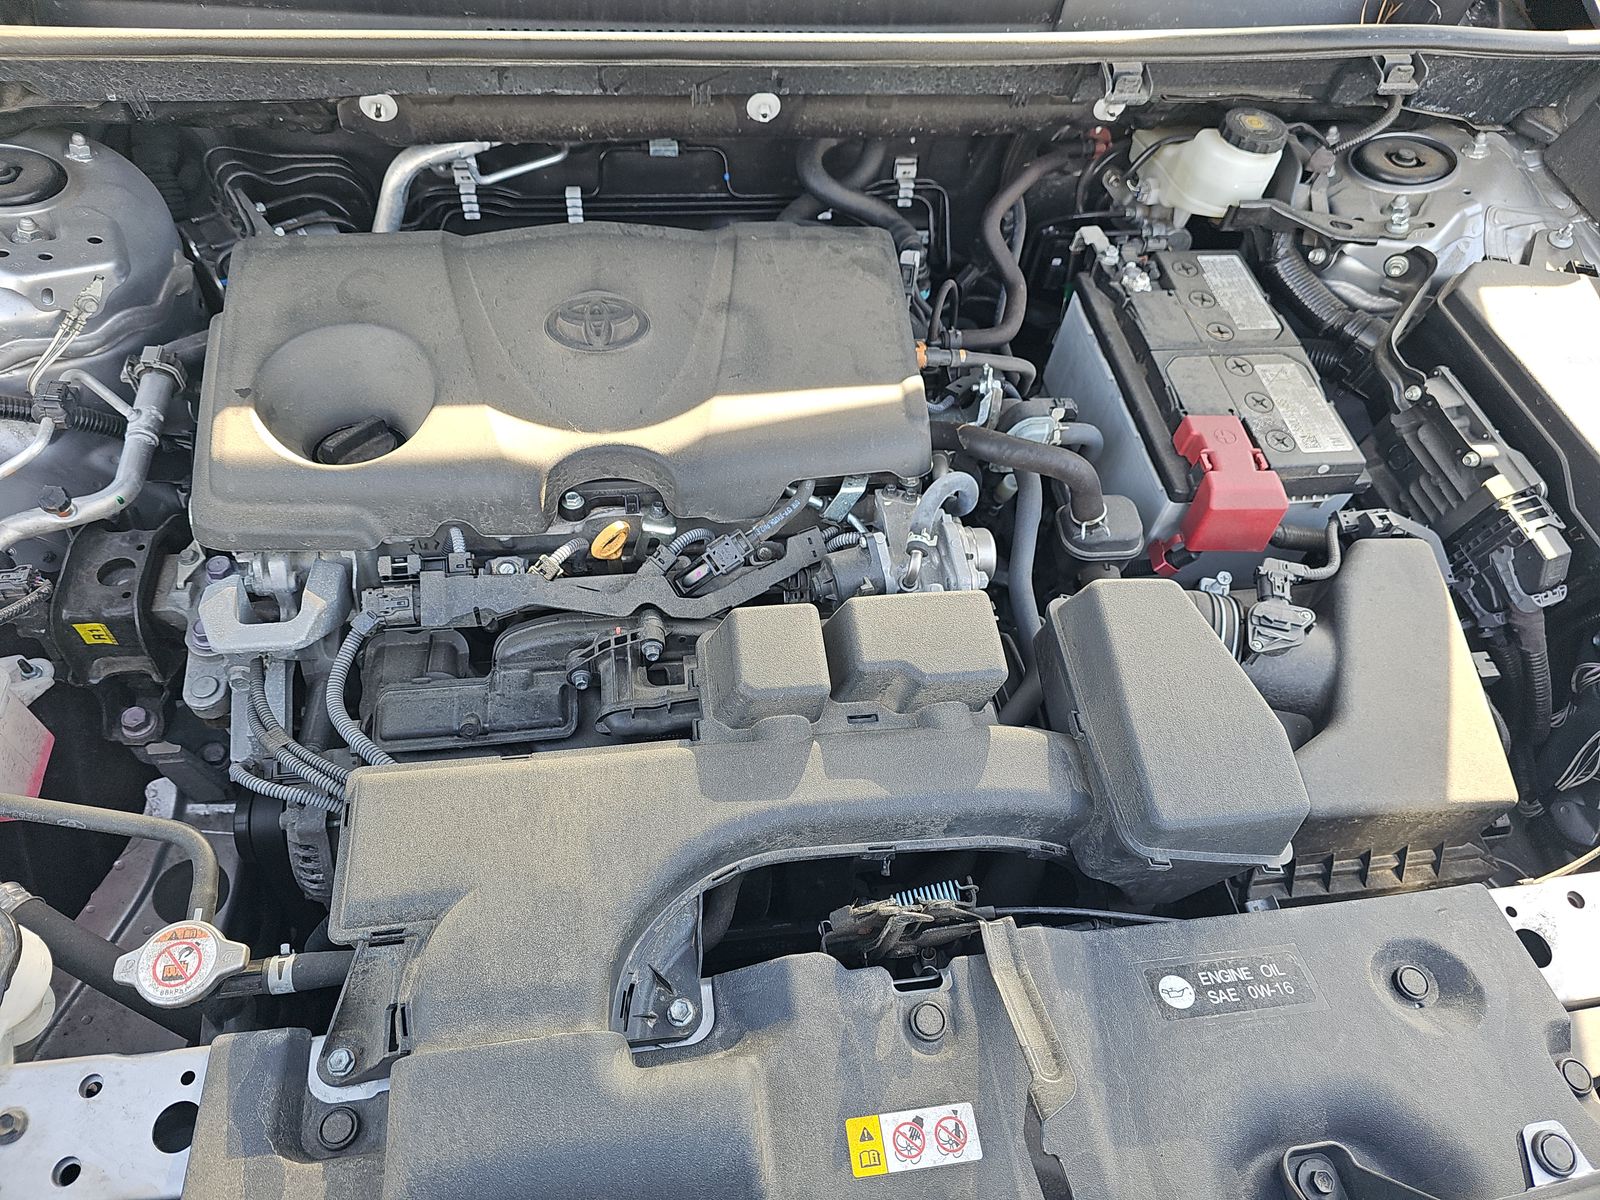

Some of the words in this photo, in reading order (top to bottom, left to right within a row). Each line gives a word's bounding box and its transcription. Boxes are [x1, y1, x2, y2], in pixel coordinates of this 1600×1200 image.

[1198, 966, 1254, 986] ENGINE
[1260, 963, 1287, 978] OIL
[1207, 987, 1240, 1004] SAE
[1247, 981, 1295, 999] 0W-16
